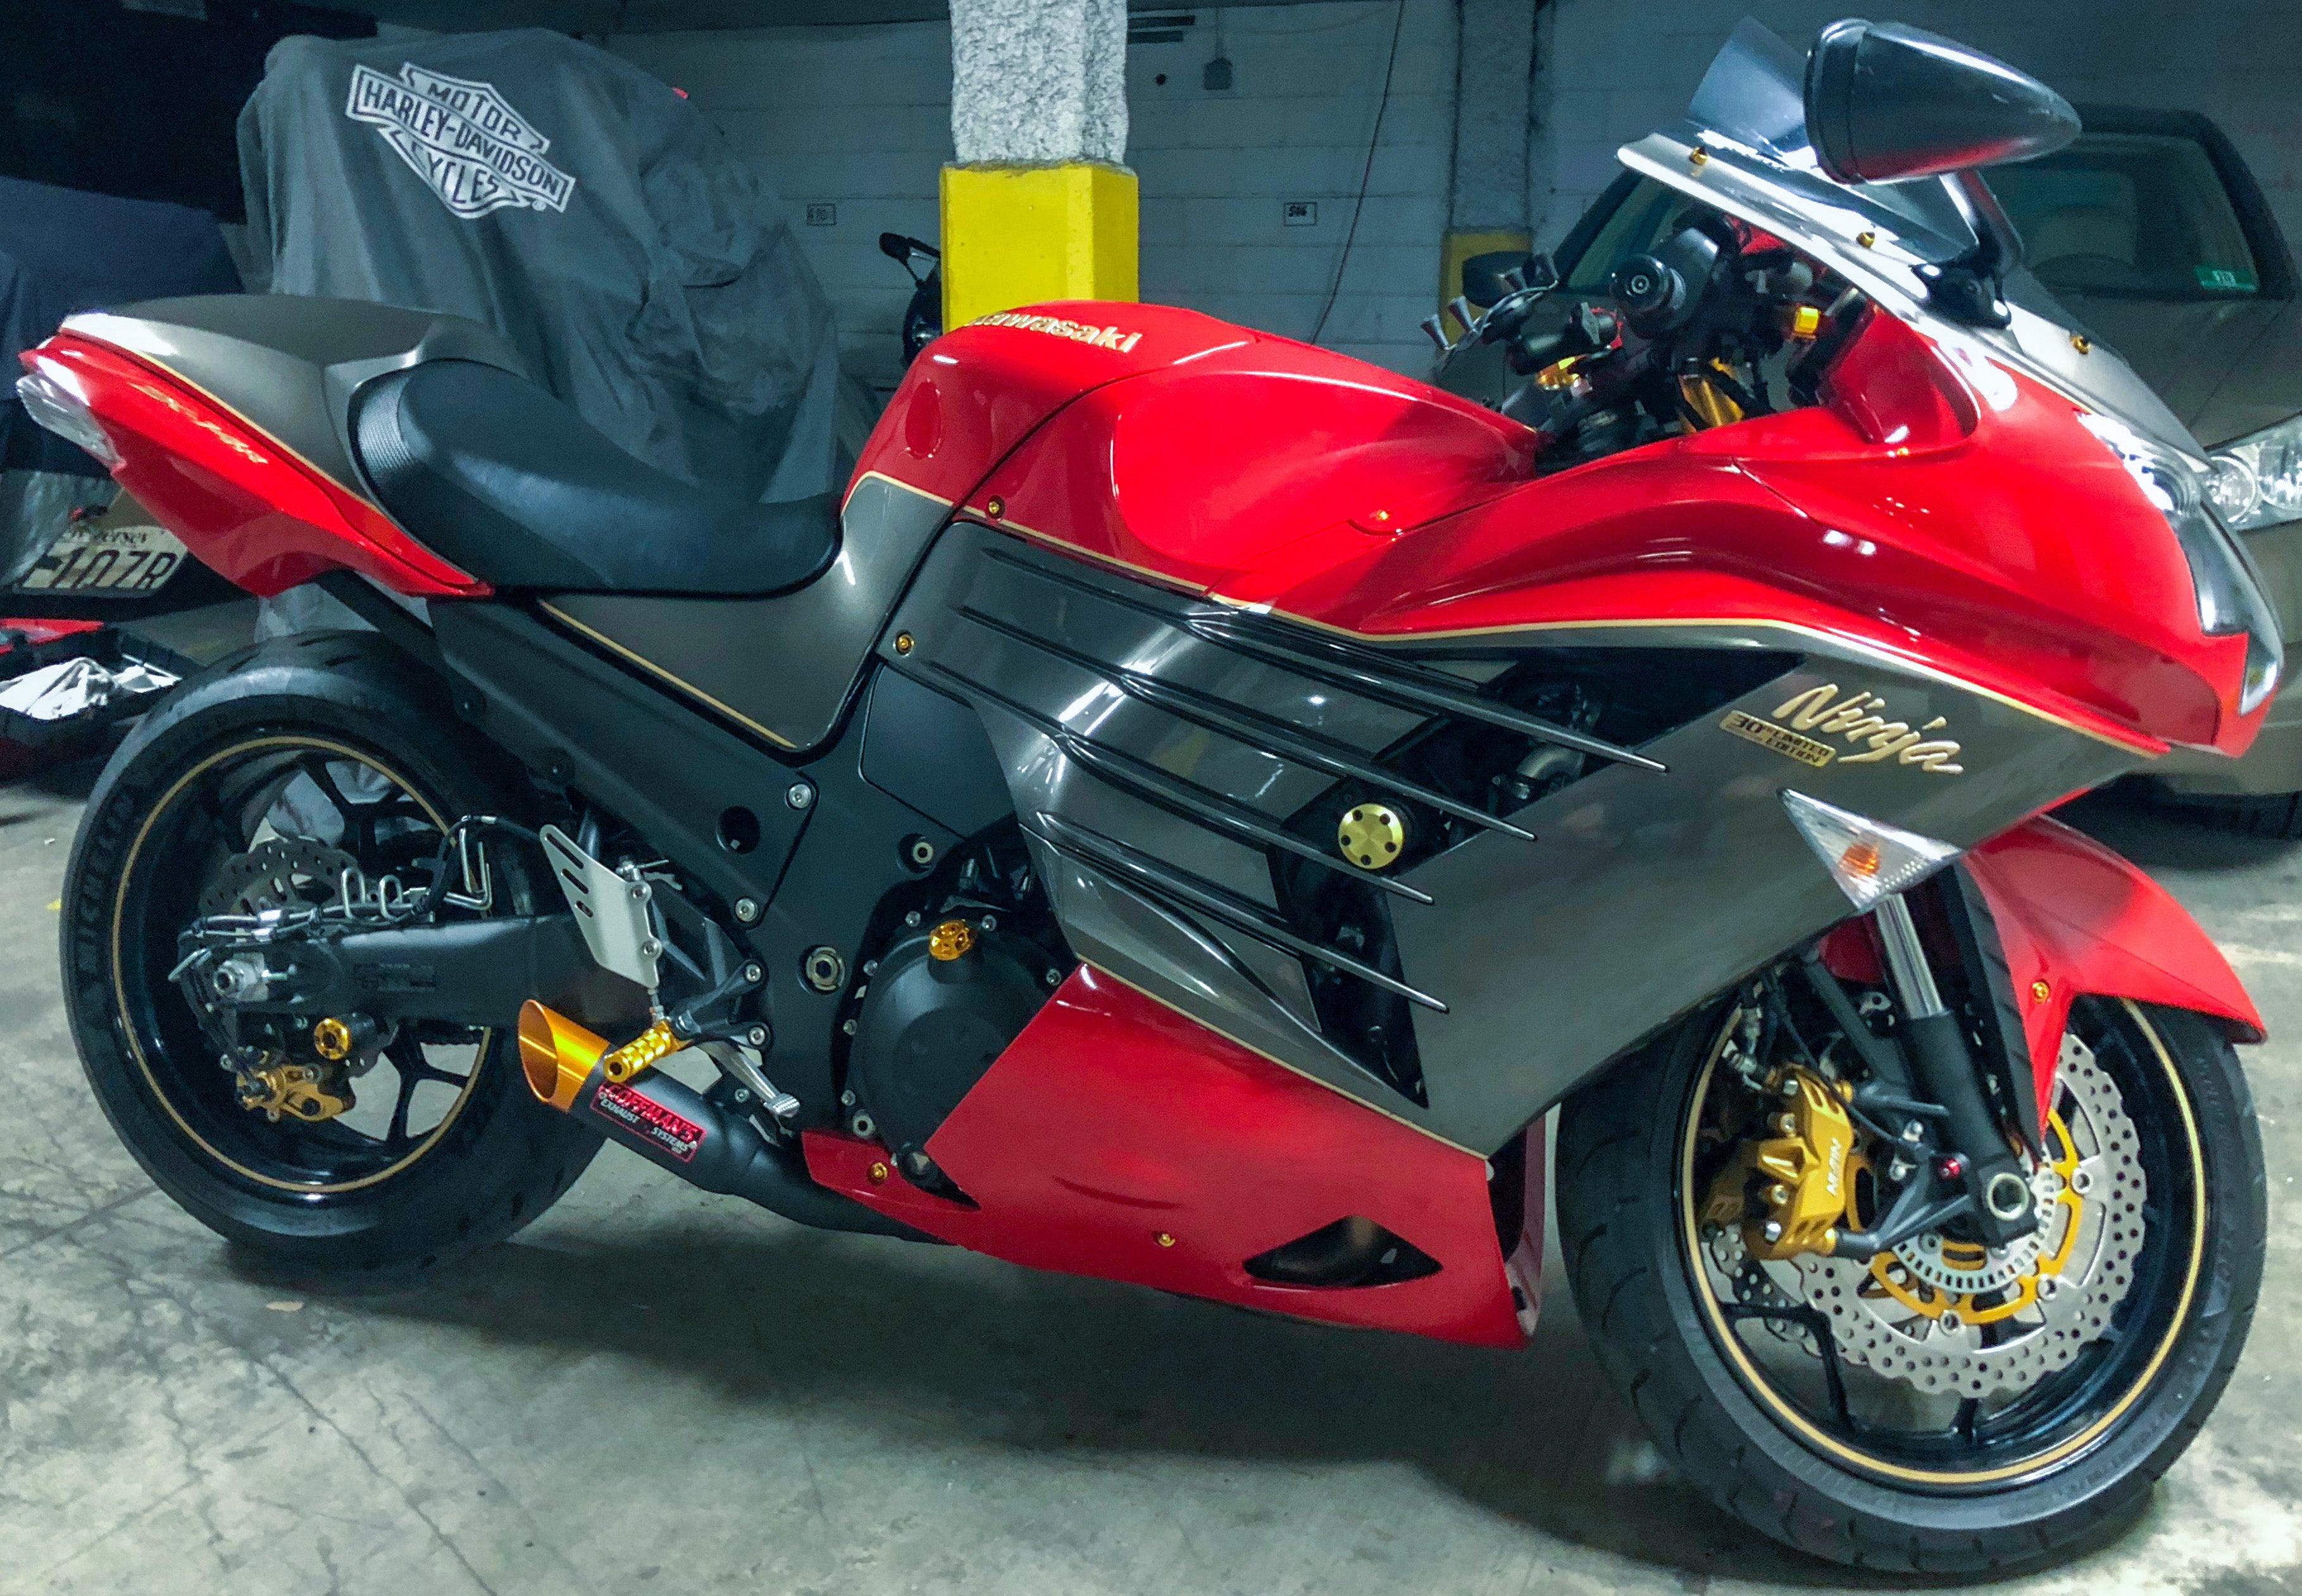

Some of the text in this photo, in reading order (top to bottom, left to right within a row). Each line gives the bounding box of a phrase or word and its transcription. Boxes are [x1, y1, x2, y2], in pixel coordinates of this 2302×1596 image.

[363, 80, 558, 196] HARLEY-DAVIDSON
[428, 84, 520, 140] MOTOR
[411, 141, 501, 203] CYCLES
[1771, 683, 1964, 775] Ninja
[600, 1098, 688, 1152] EXHAUST SYSTEMS
